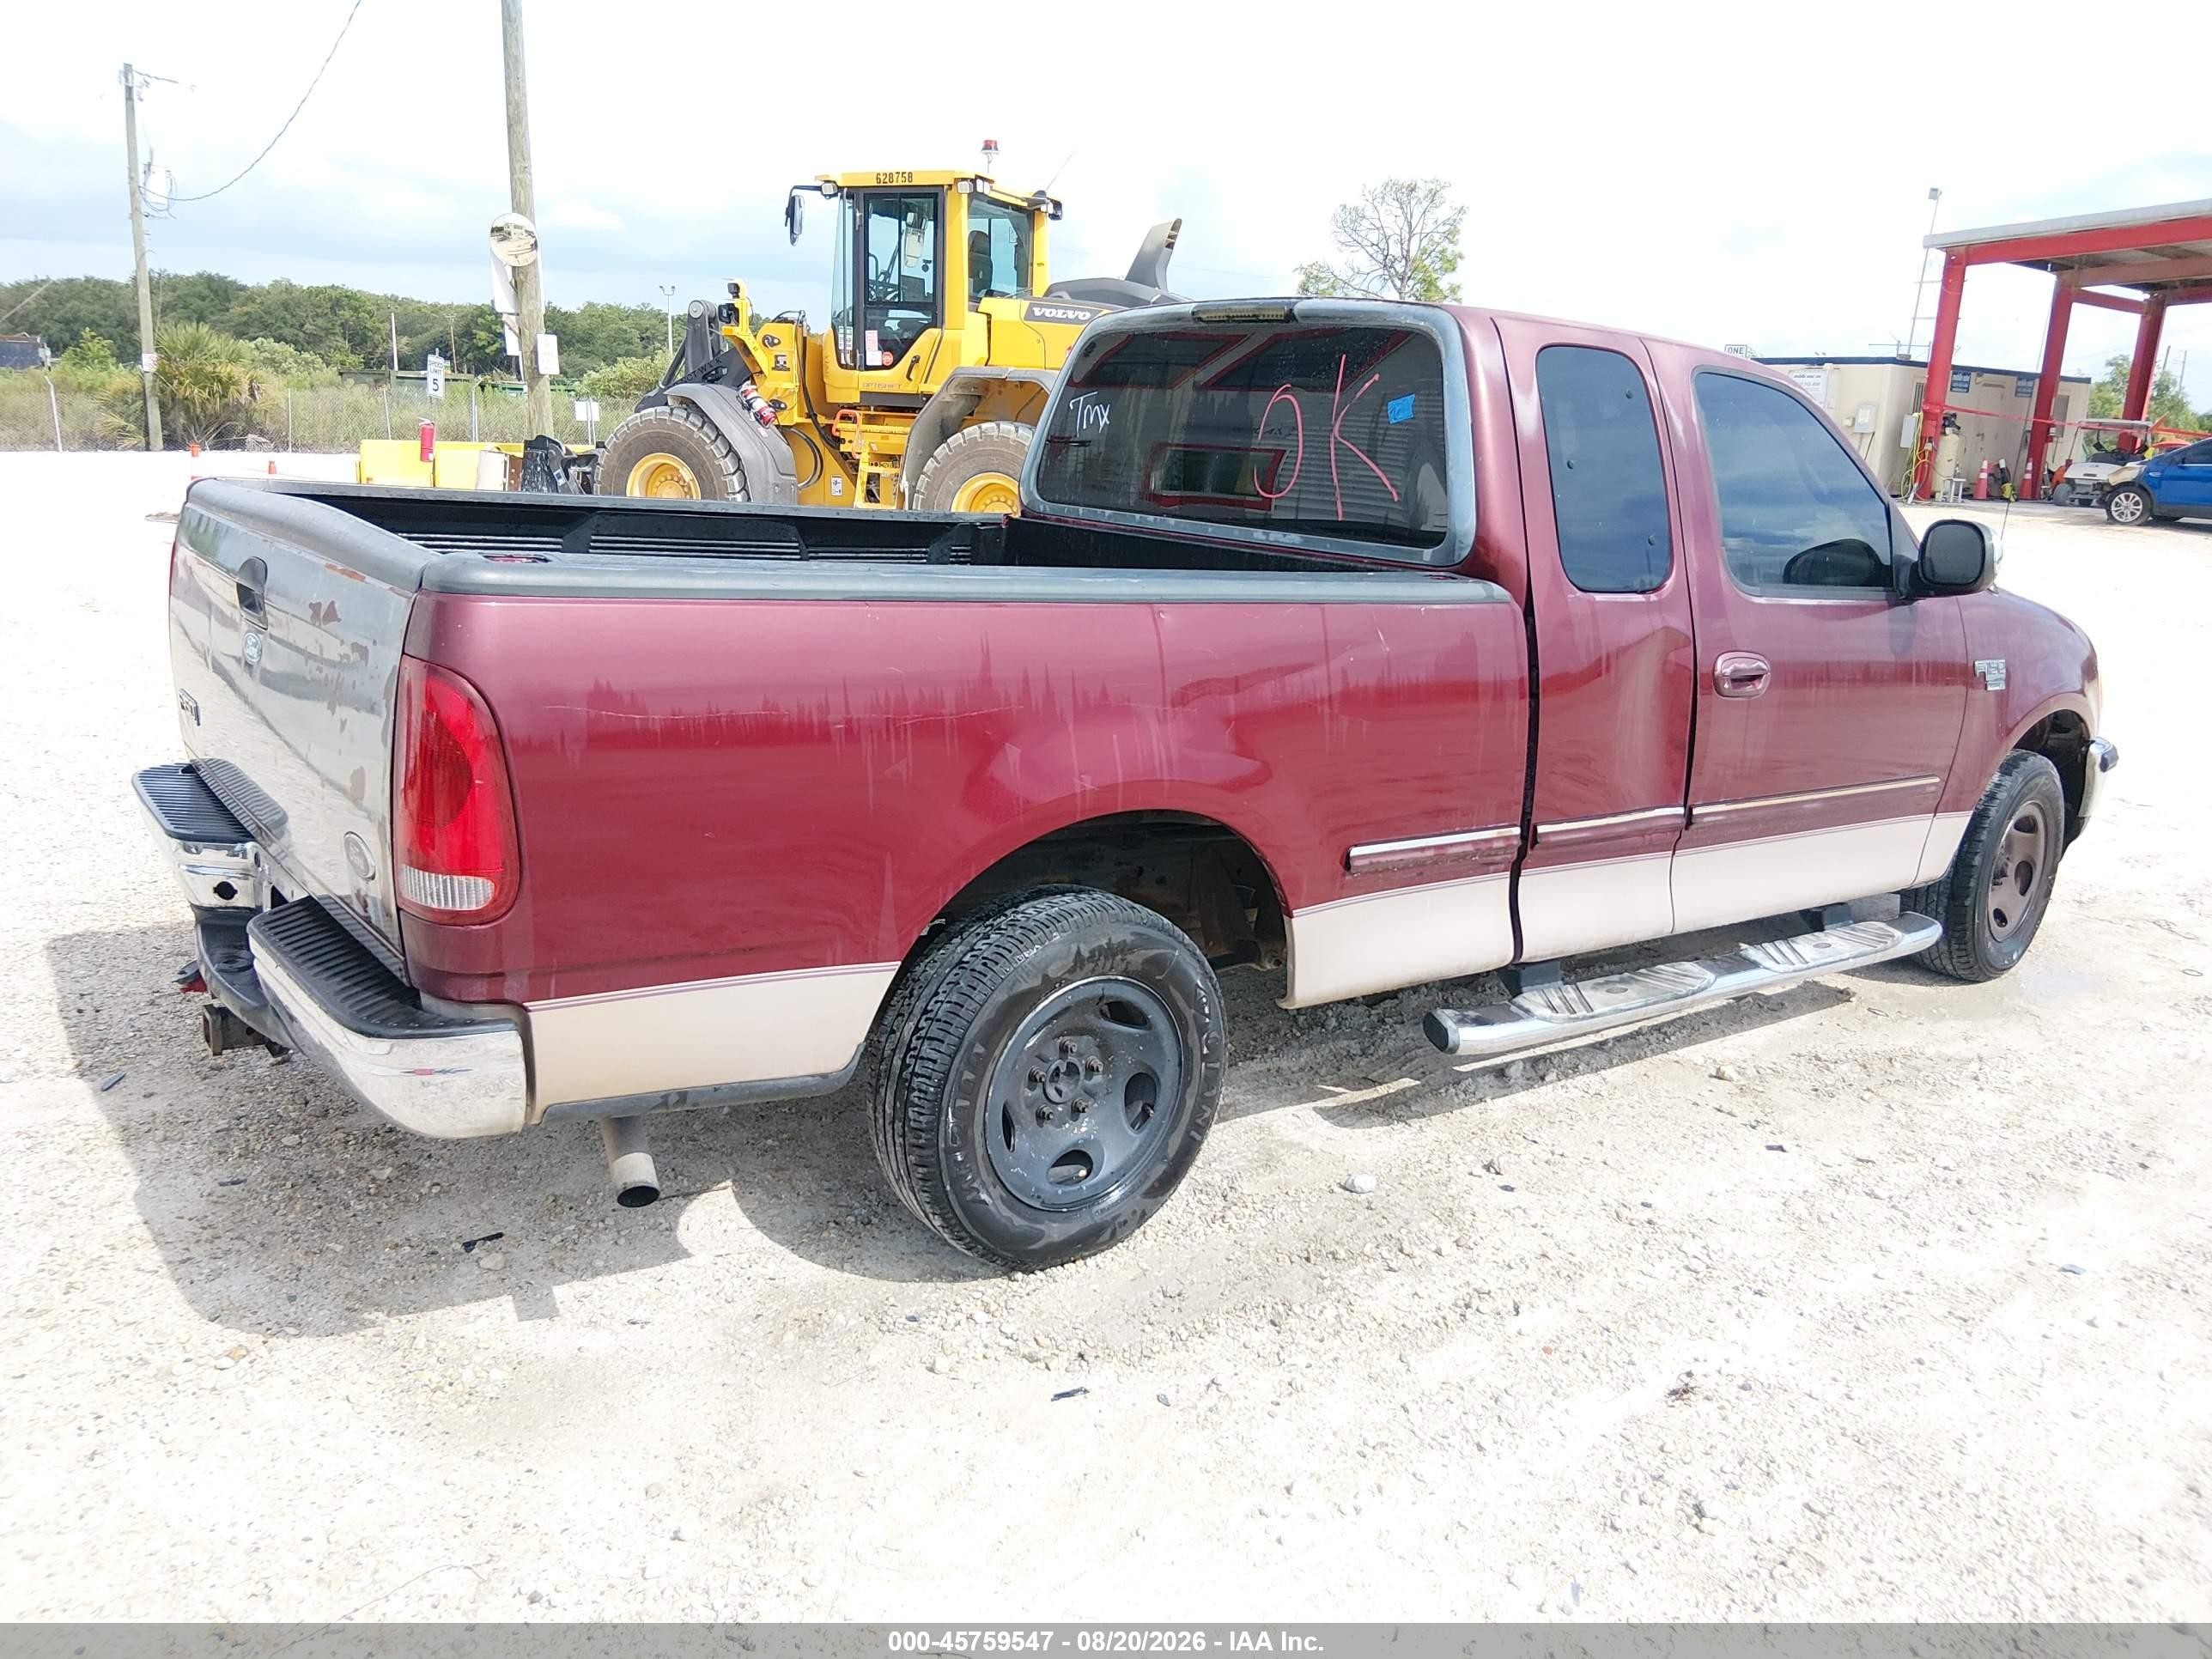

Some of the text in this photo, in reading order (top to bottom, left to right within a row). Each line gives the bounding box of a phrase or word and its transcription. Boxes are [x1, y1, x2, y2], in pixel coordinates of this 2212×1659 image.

[876, 171, 913, 185] 628758
[1032, 307, 1091, 321] VOLVO
[1727, 346, 1745, 356] ONE
[432, 378, 440, 392] 5
[1254, 353, 1399, 522] OK
